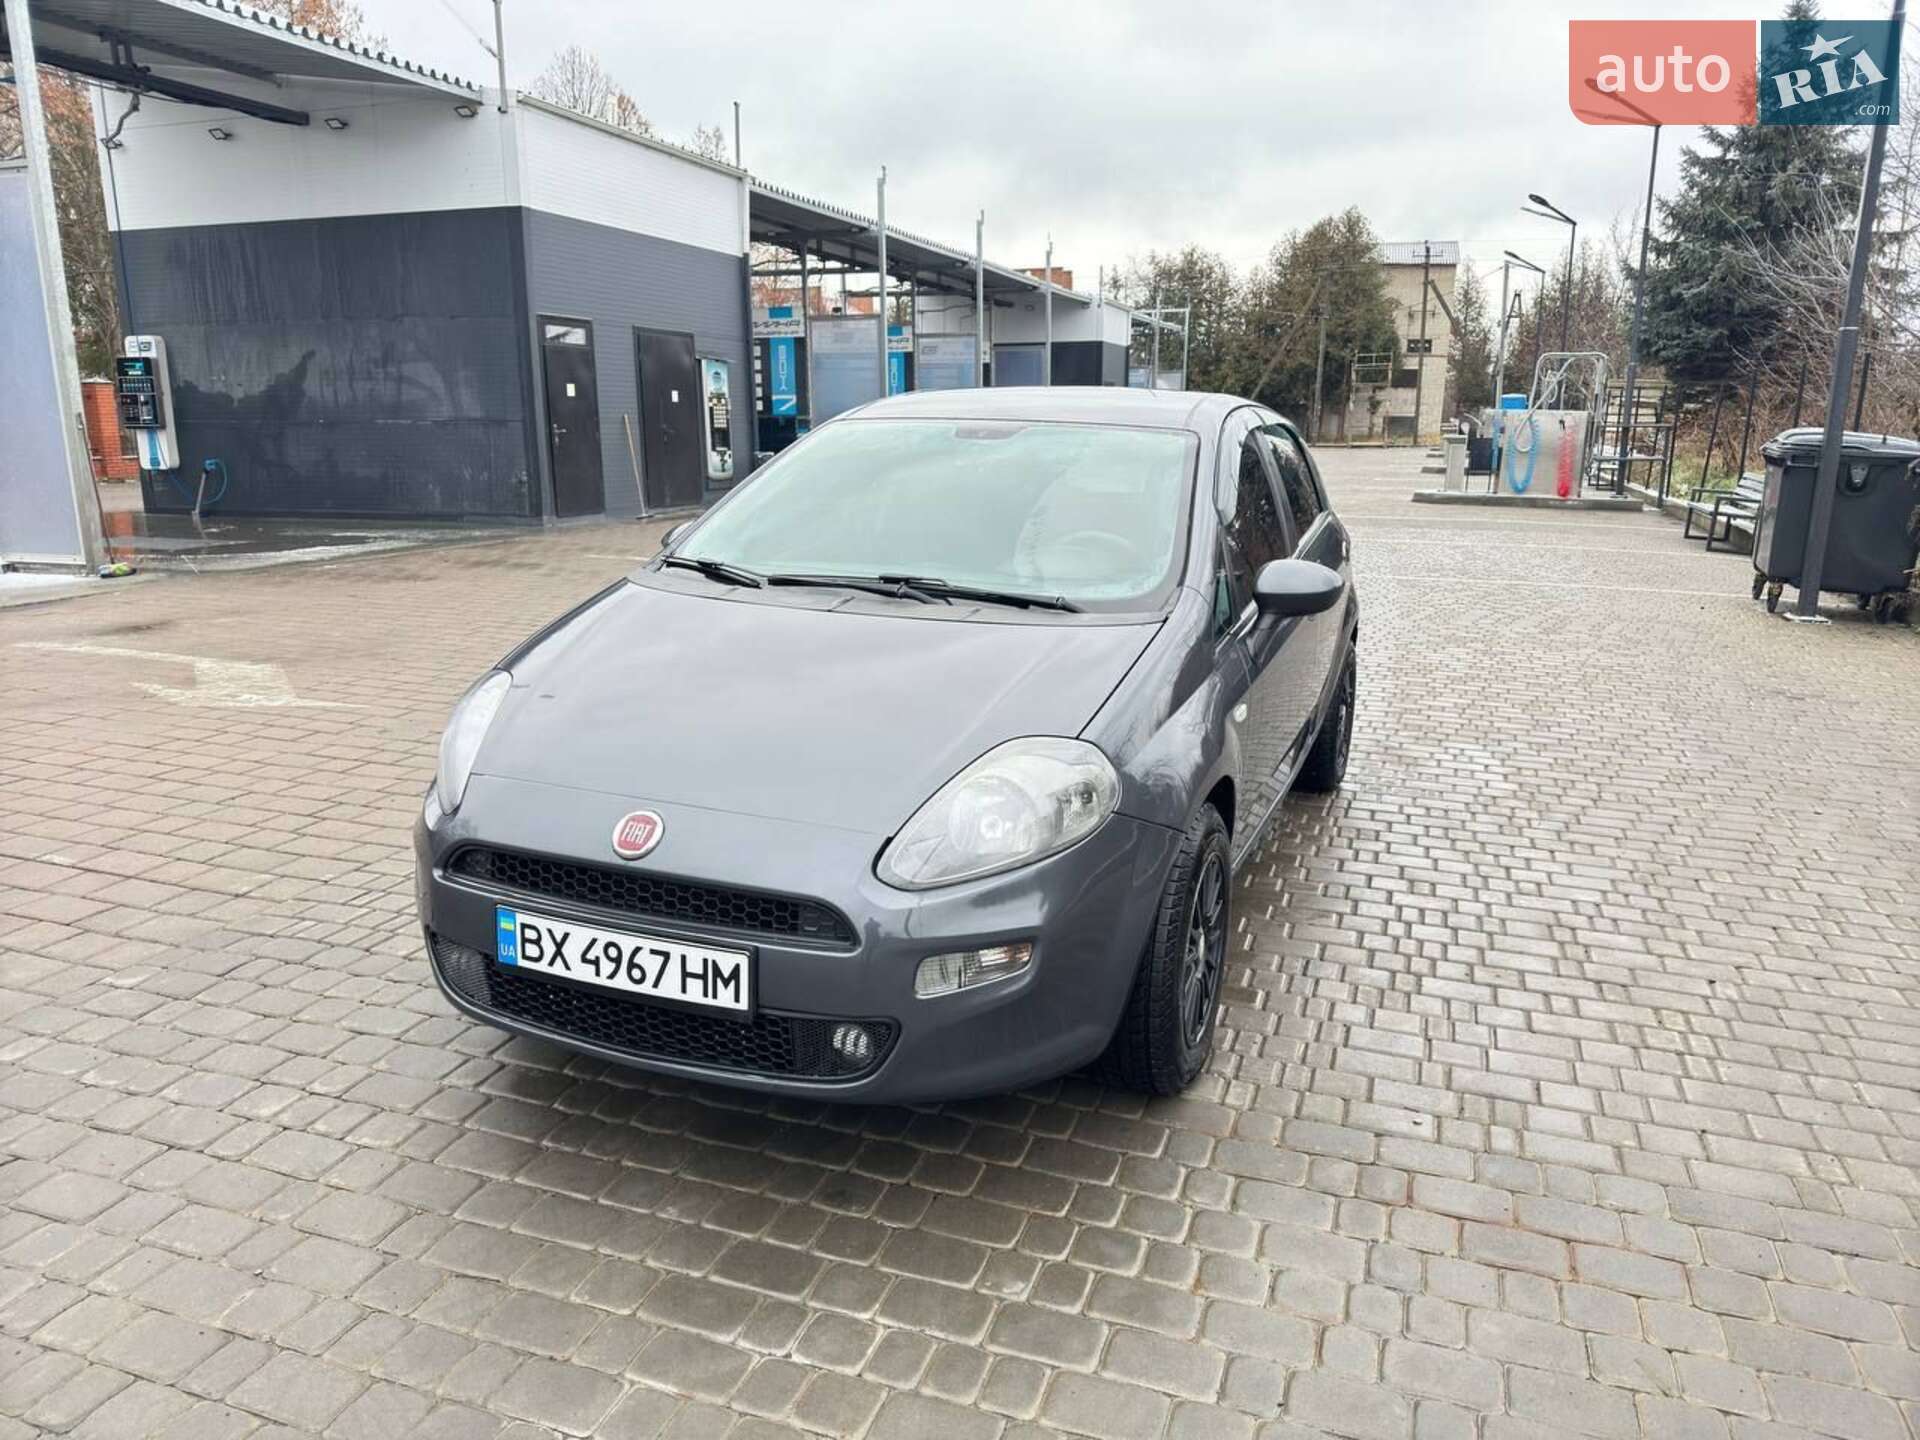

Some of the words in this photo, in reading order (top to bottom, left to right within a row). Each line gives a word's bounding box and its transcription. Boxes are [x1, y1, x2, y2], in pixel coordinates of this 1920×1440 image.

[620, 820, 653, 845] FIAT
[499, 943, 515, 957] UA
[520, 922, 571, 971] BX
[580, 937, 671, 989] 4967
[680, 954, 740, 1003] HM
